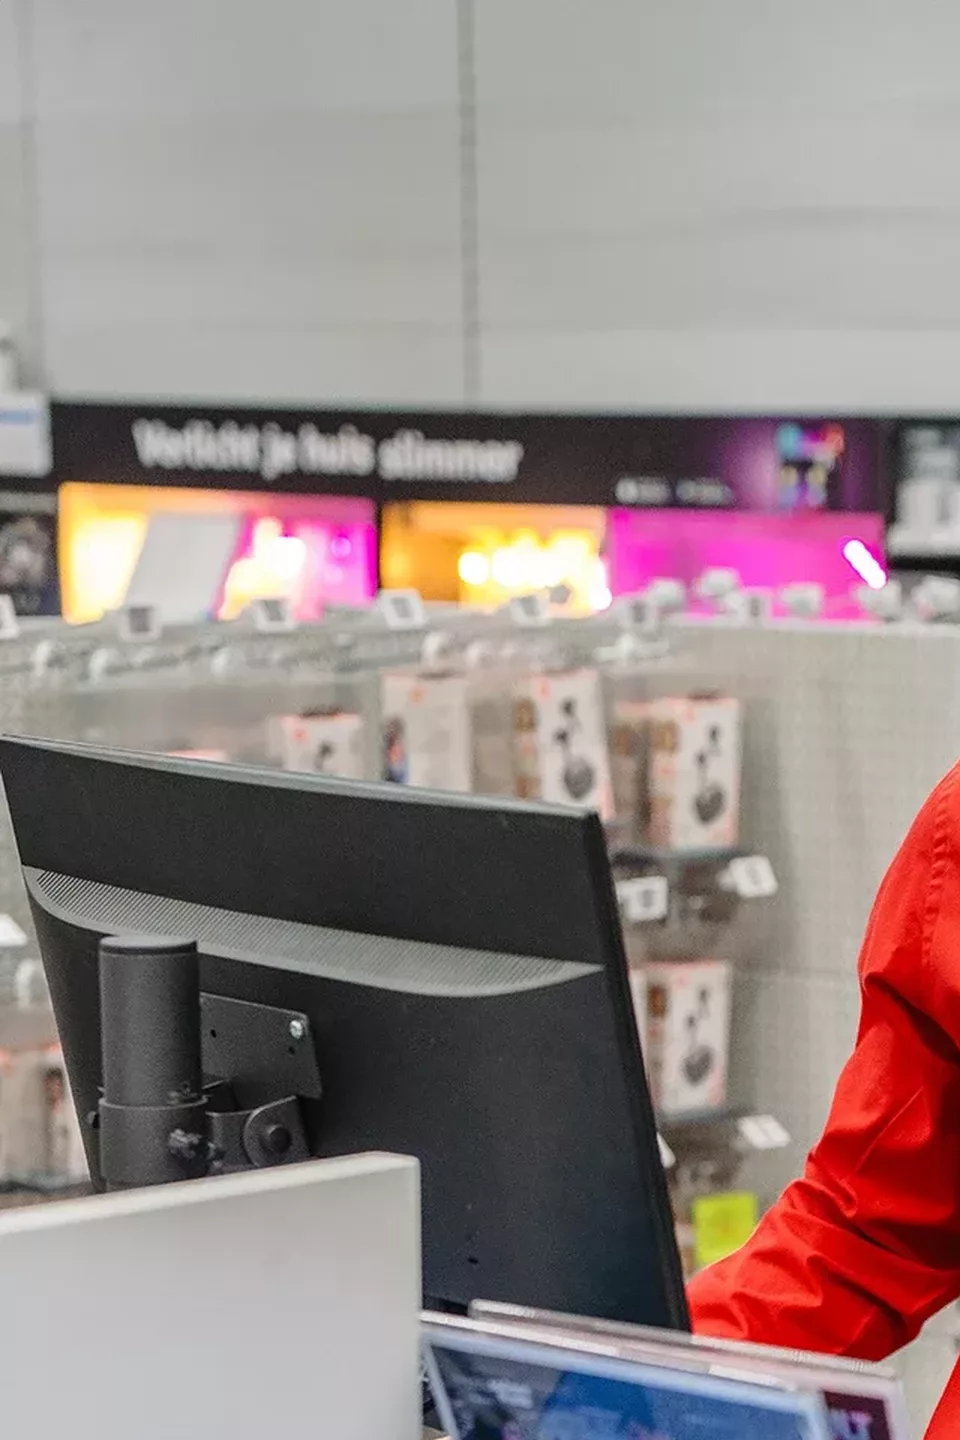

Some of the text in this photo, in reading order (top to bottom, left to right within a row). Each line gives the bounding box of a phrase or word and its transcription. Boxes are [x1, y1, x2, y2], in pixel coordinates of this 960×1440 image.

[260, 421, 297, 480] je
[299, 422, 375, 477] huis
[377, 428, 524, 483] slimmer
